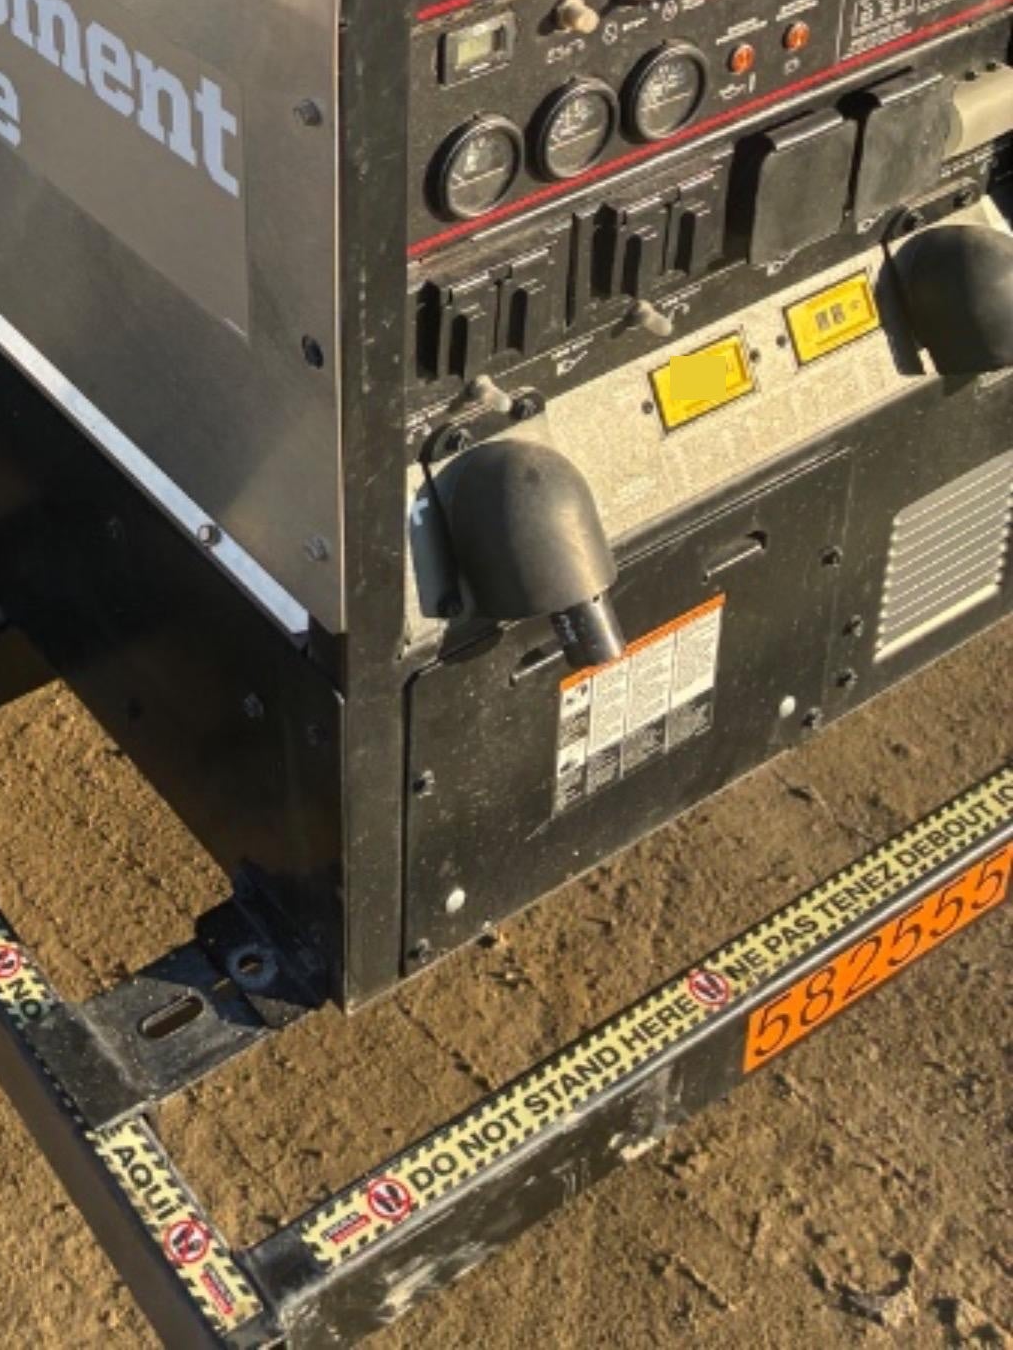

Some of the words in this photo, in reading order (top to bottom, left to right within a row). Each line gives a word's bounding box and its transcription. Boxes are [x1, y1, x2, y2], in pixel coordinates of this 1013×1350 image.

[408, 1156, 459, 1192] DO
[458, 1104, 524, 1159] NOT
[522, 1041, 622, 1116] STAND
[618, 991, 700, 1046] HERE
[722, 945, 766, 981] NE
[762, 912, 820, 953] PAS
[813, 857, 899, 919] TENEZ
[893, 800, 995, 869] DEBOUT
[753, 850, 1006, 1058] 582555
